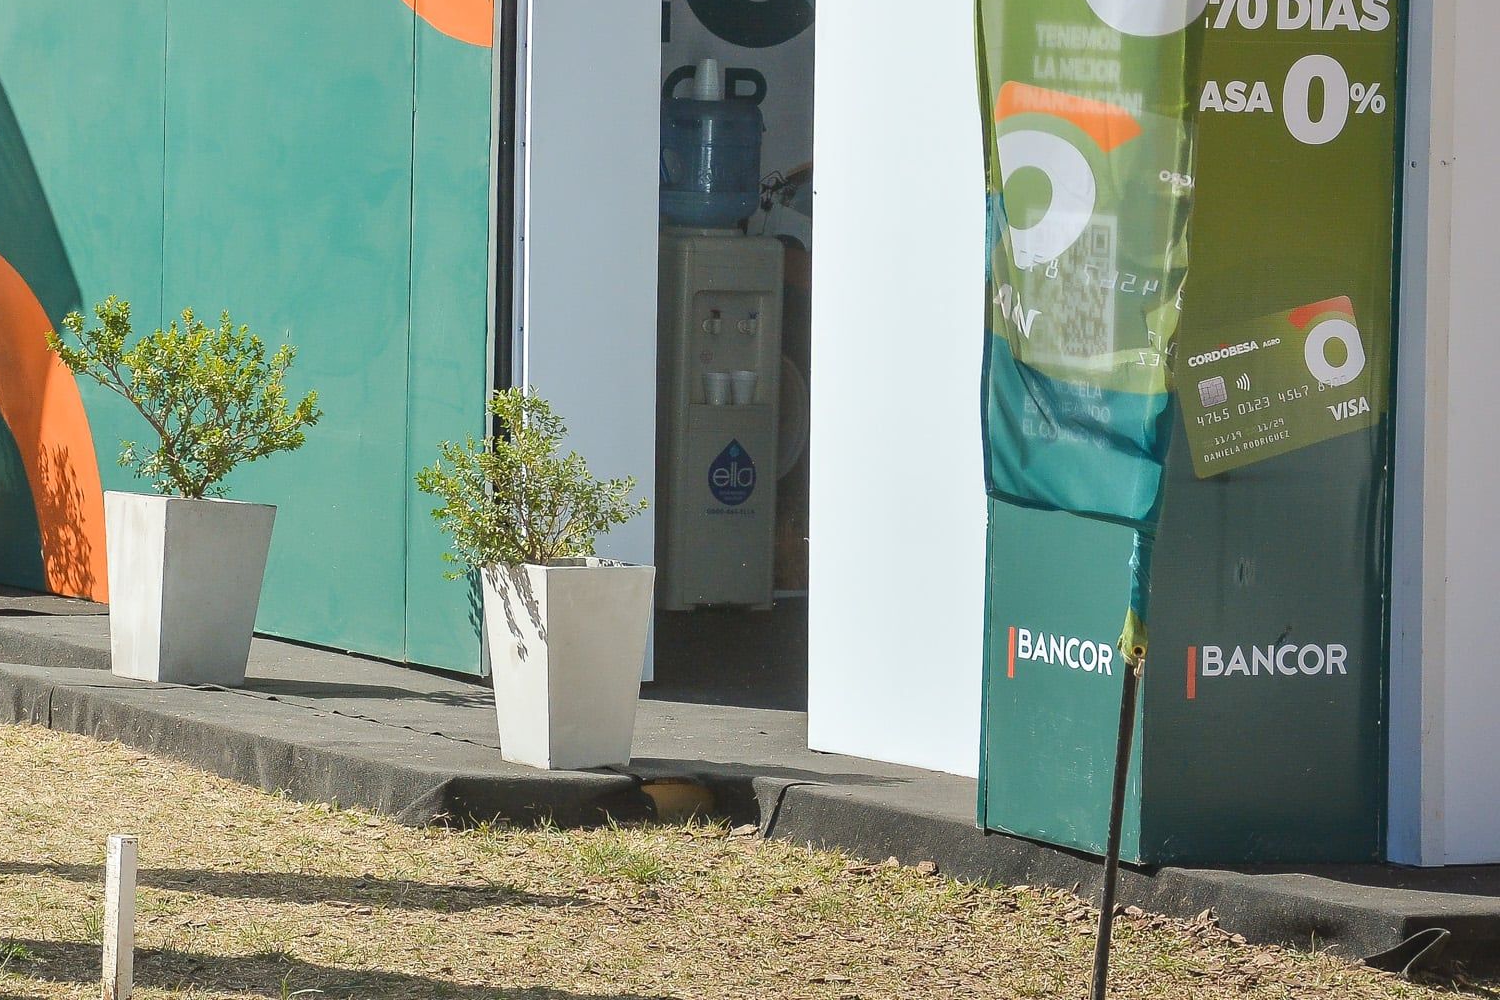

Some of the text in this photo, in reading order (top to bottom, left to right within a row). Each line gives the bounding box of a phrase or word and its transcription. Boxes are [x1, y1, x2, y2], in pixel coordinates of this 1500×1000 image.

[1199, 80, 1274, 113] ASA
[1187, 339, 1260, 368] CORDOBESA
[1262, 337, 1281, 349] AGRO
[1196, 407, 1231, 427] 4765
[1237, 396, 1271, 415] 0123
[1277, 385, 1310, 403] 4567
[1325, 396, 1371, 421] VISA
[1203, 430, 1291, 463] DANIELA RODRIGUEZ
[1213, 417, 1286, 446] 11/19 11/29
[712, 461, 753, 488] ella
[1018, 628, 1113, 677] BANCOR
[1202, 644, 1347, 676] BANCOR
